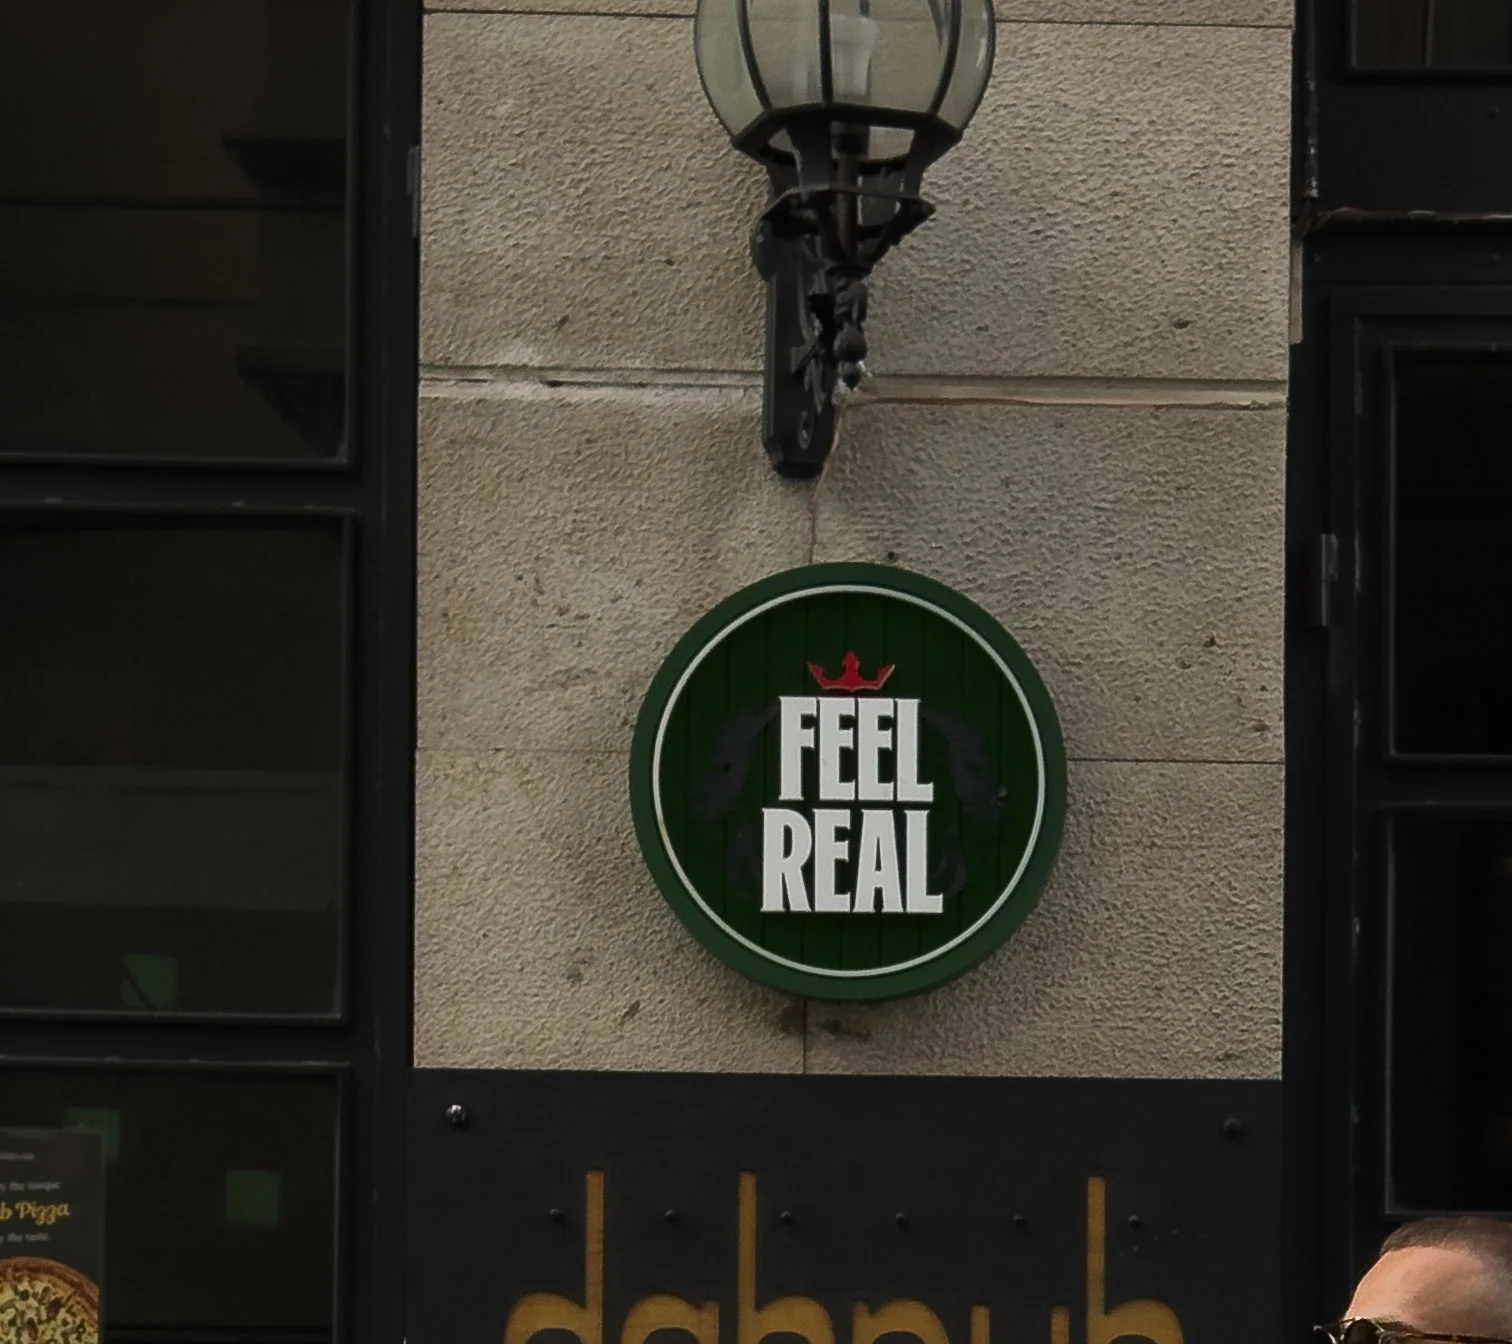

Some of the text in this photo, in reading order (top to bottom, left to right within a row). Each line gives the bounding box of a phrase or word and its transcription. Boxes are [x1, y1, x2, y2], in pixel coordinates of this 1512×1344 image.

[778, 696, 934, 802] FEEL
[760, 807, 944, 913] REAL
[15, 1200, 71, 1226] Pizza
